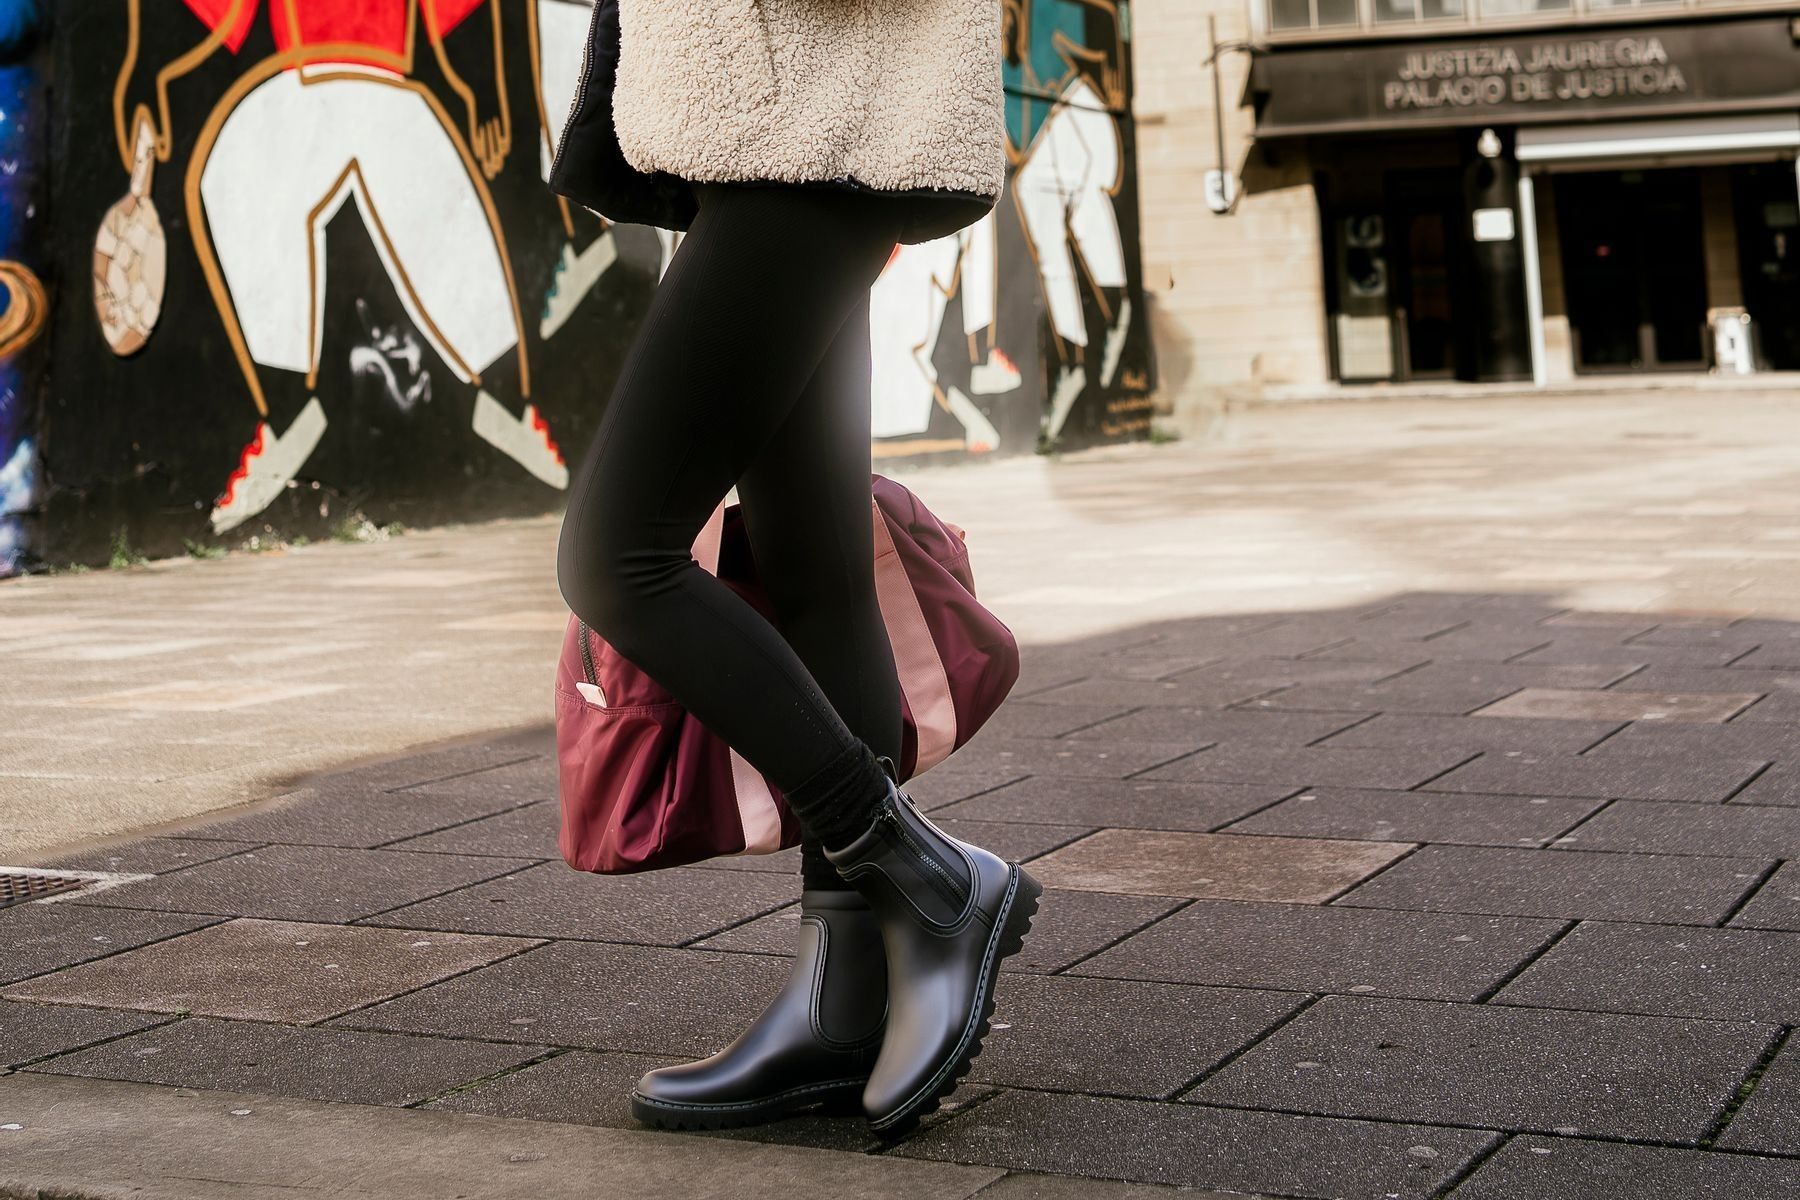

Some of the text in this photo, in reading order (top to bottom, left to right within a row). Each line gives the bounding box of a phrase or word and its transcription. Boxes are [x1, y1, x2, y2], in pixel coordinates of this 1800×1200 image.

[1398, 38, 1668, 80] JUSTIZIA JAUREGIA
[1384, 64, 1688, 110] PALACIO DE JUSTICIA
